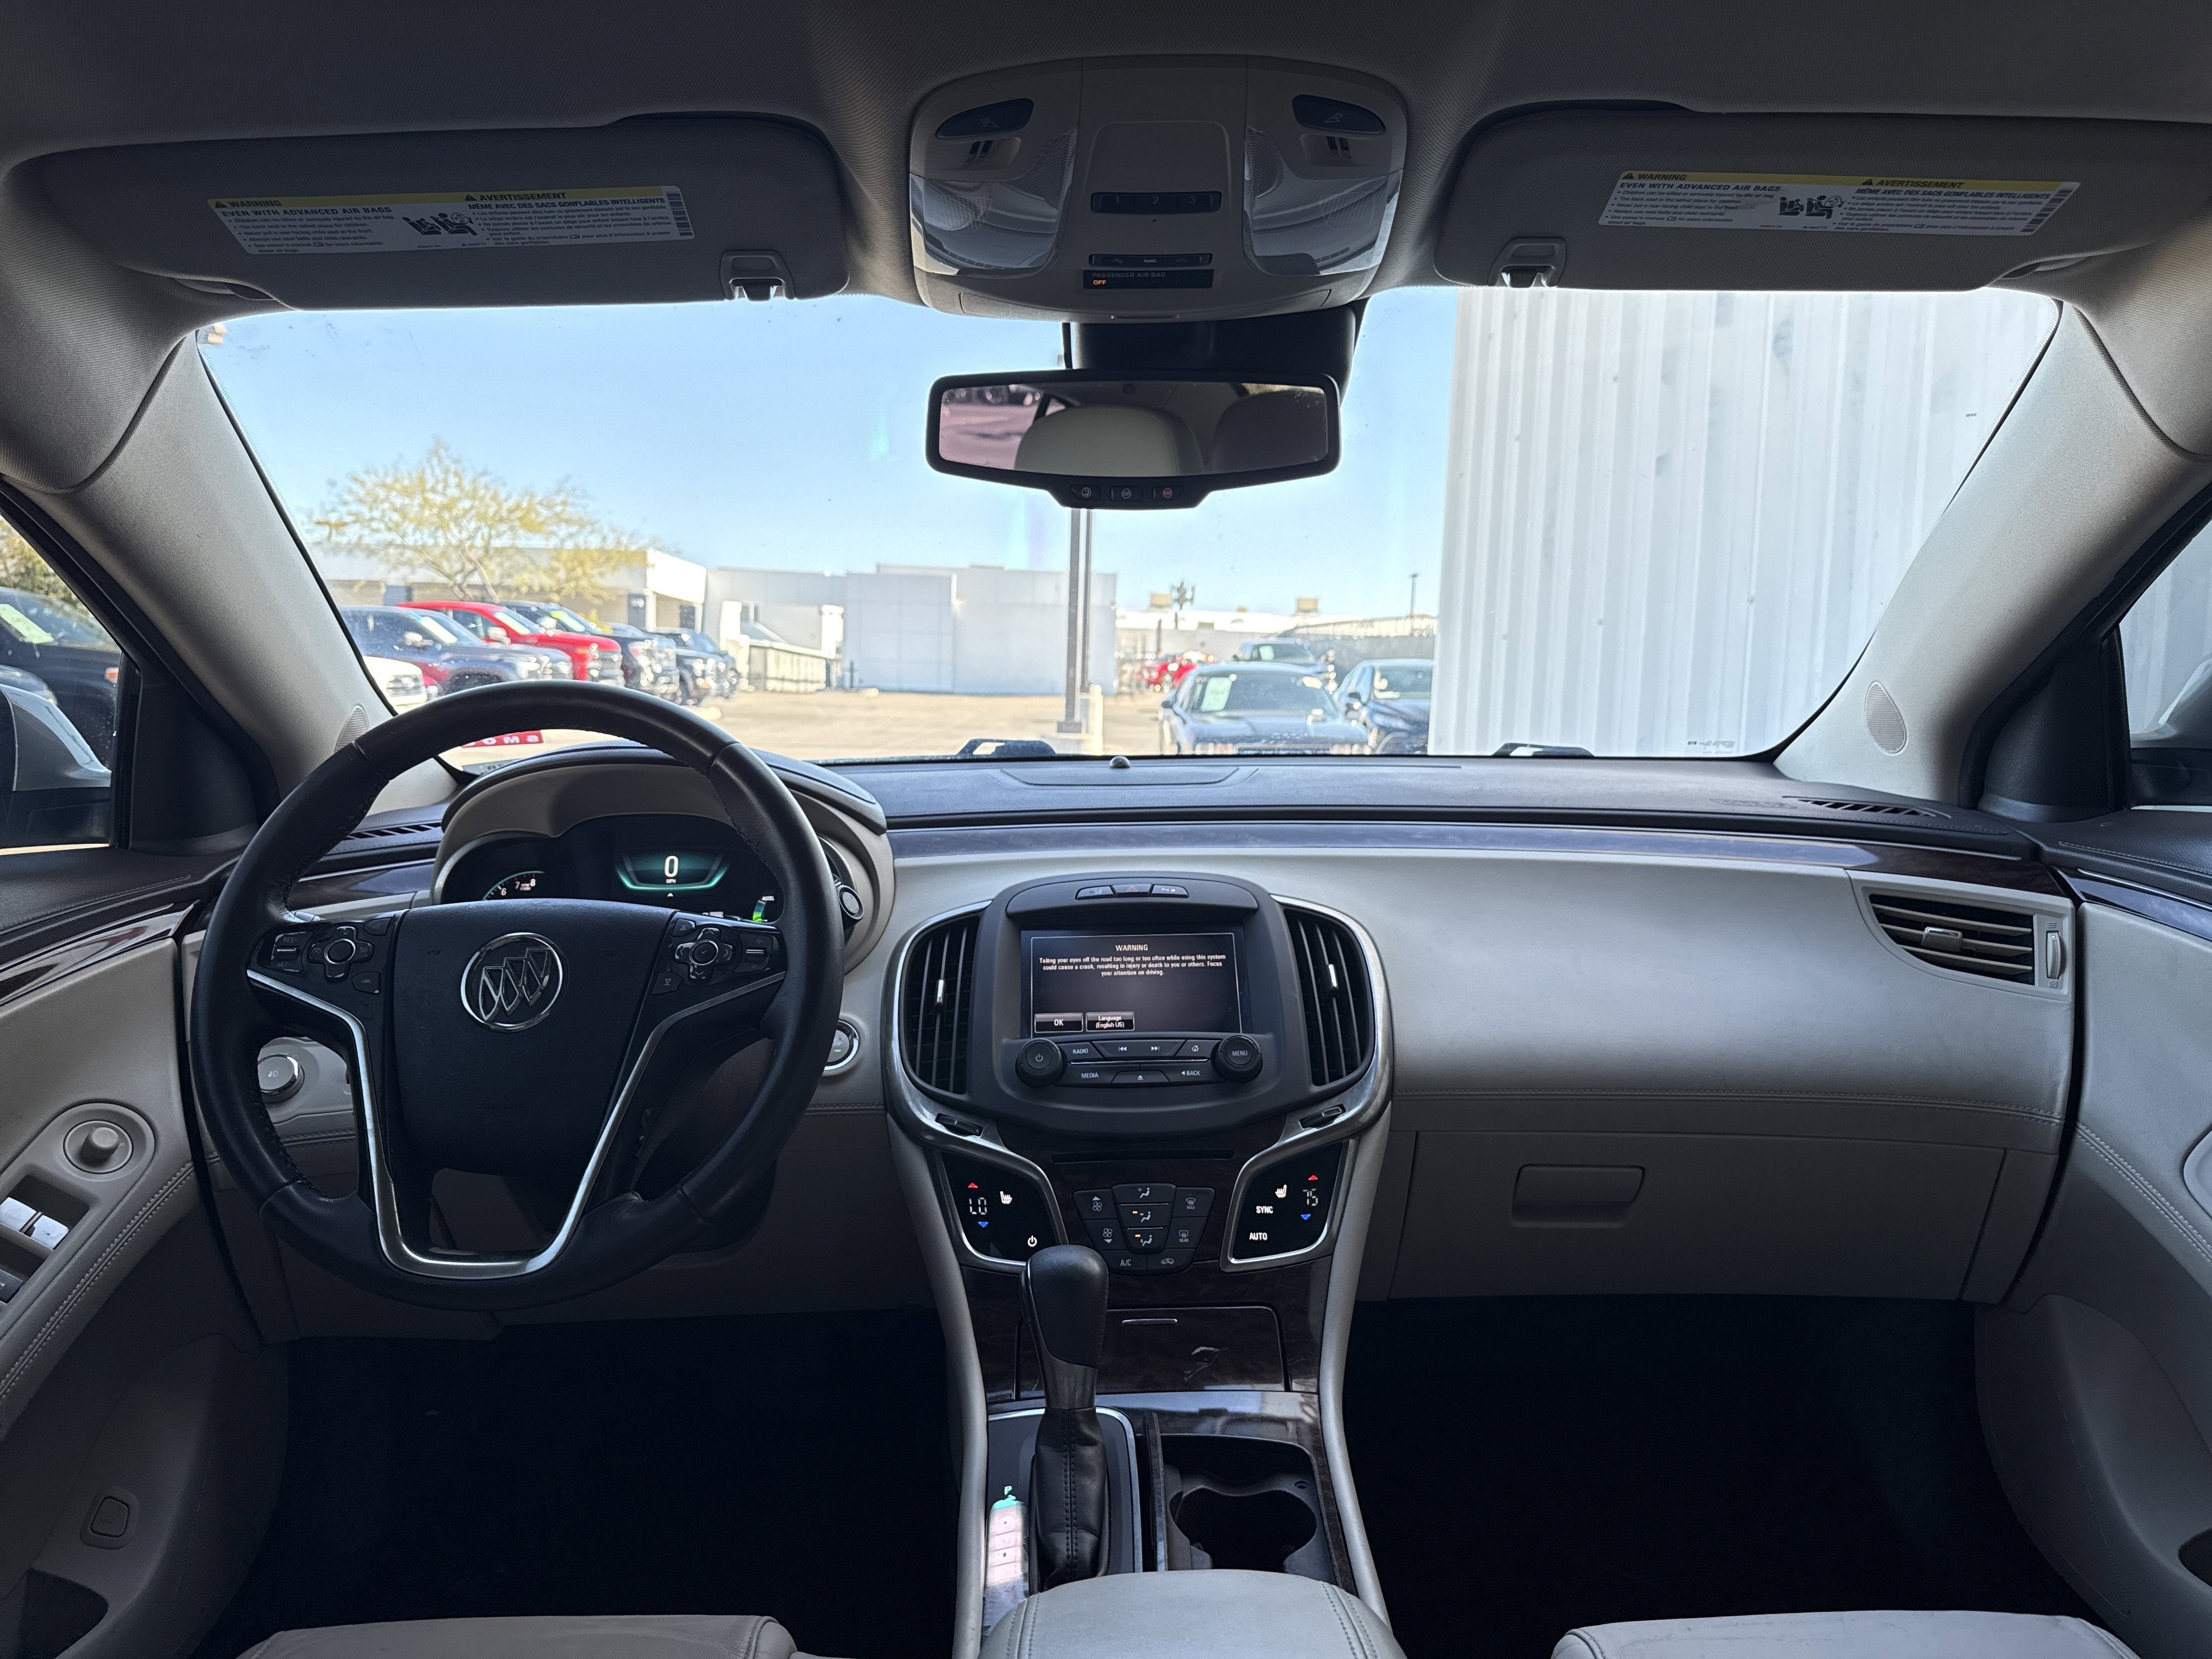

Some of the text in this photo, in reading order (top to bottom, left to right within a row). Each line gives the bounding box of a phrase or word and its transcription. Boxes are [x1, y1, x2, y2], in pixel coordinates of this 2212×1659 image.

[480, 193, 566, 201] AVERTISSEMENT
[664, 855, 678, 877] 0
[515, 881, 520, 889] 7
[530, 878, 536, 887] 8
[501, 888, 506, 896] 6
[1302, 1188, 1318, 1206] 75
[1249, 1232, 1267, 1240] AUTO
[1004, 1486, 1012, 1496] P
